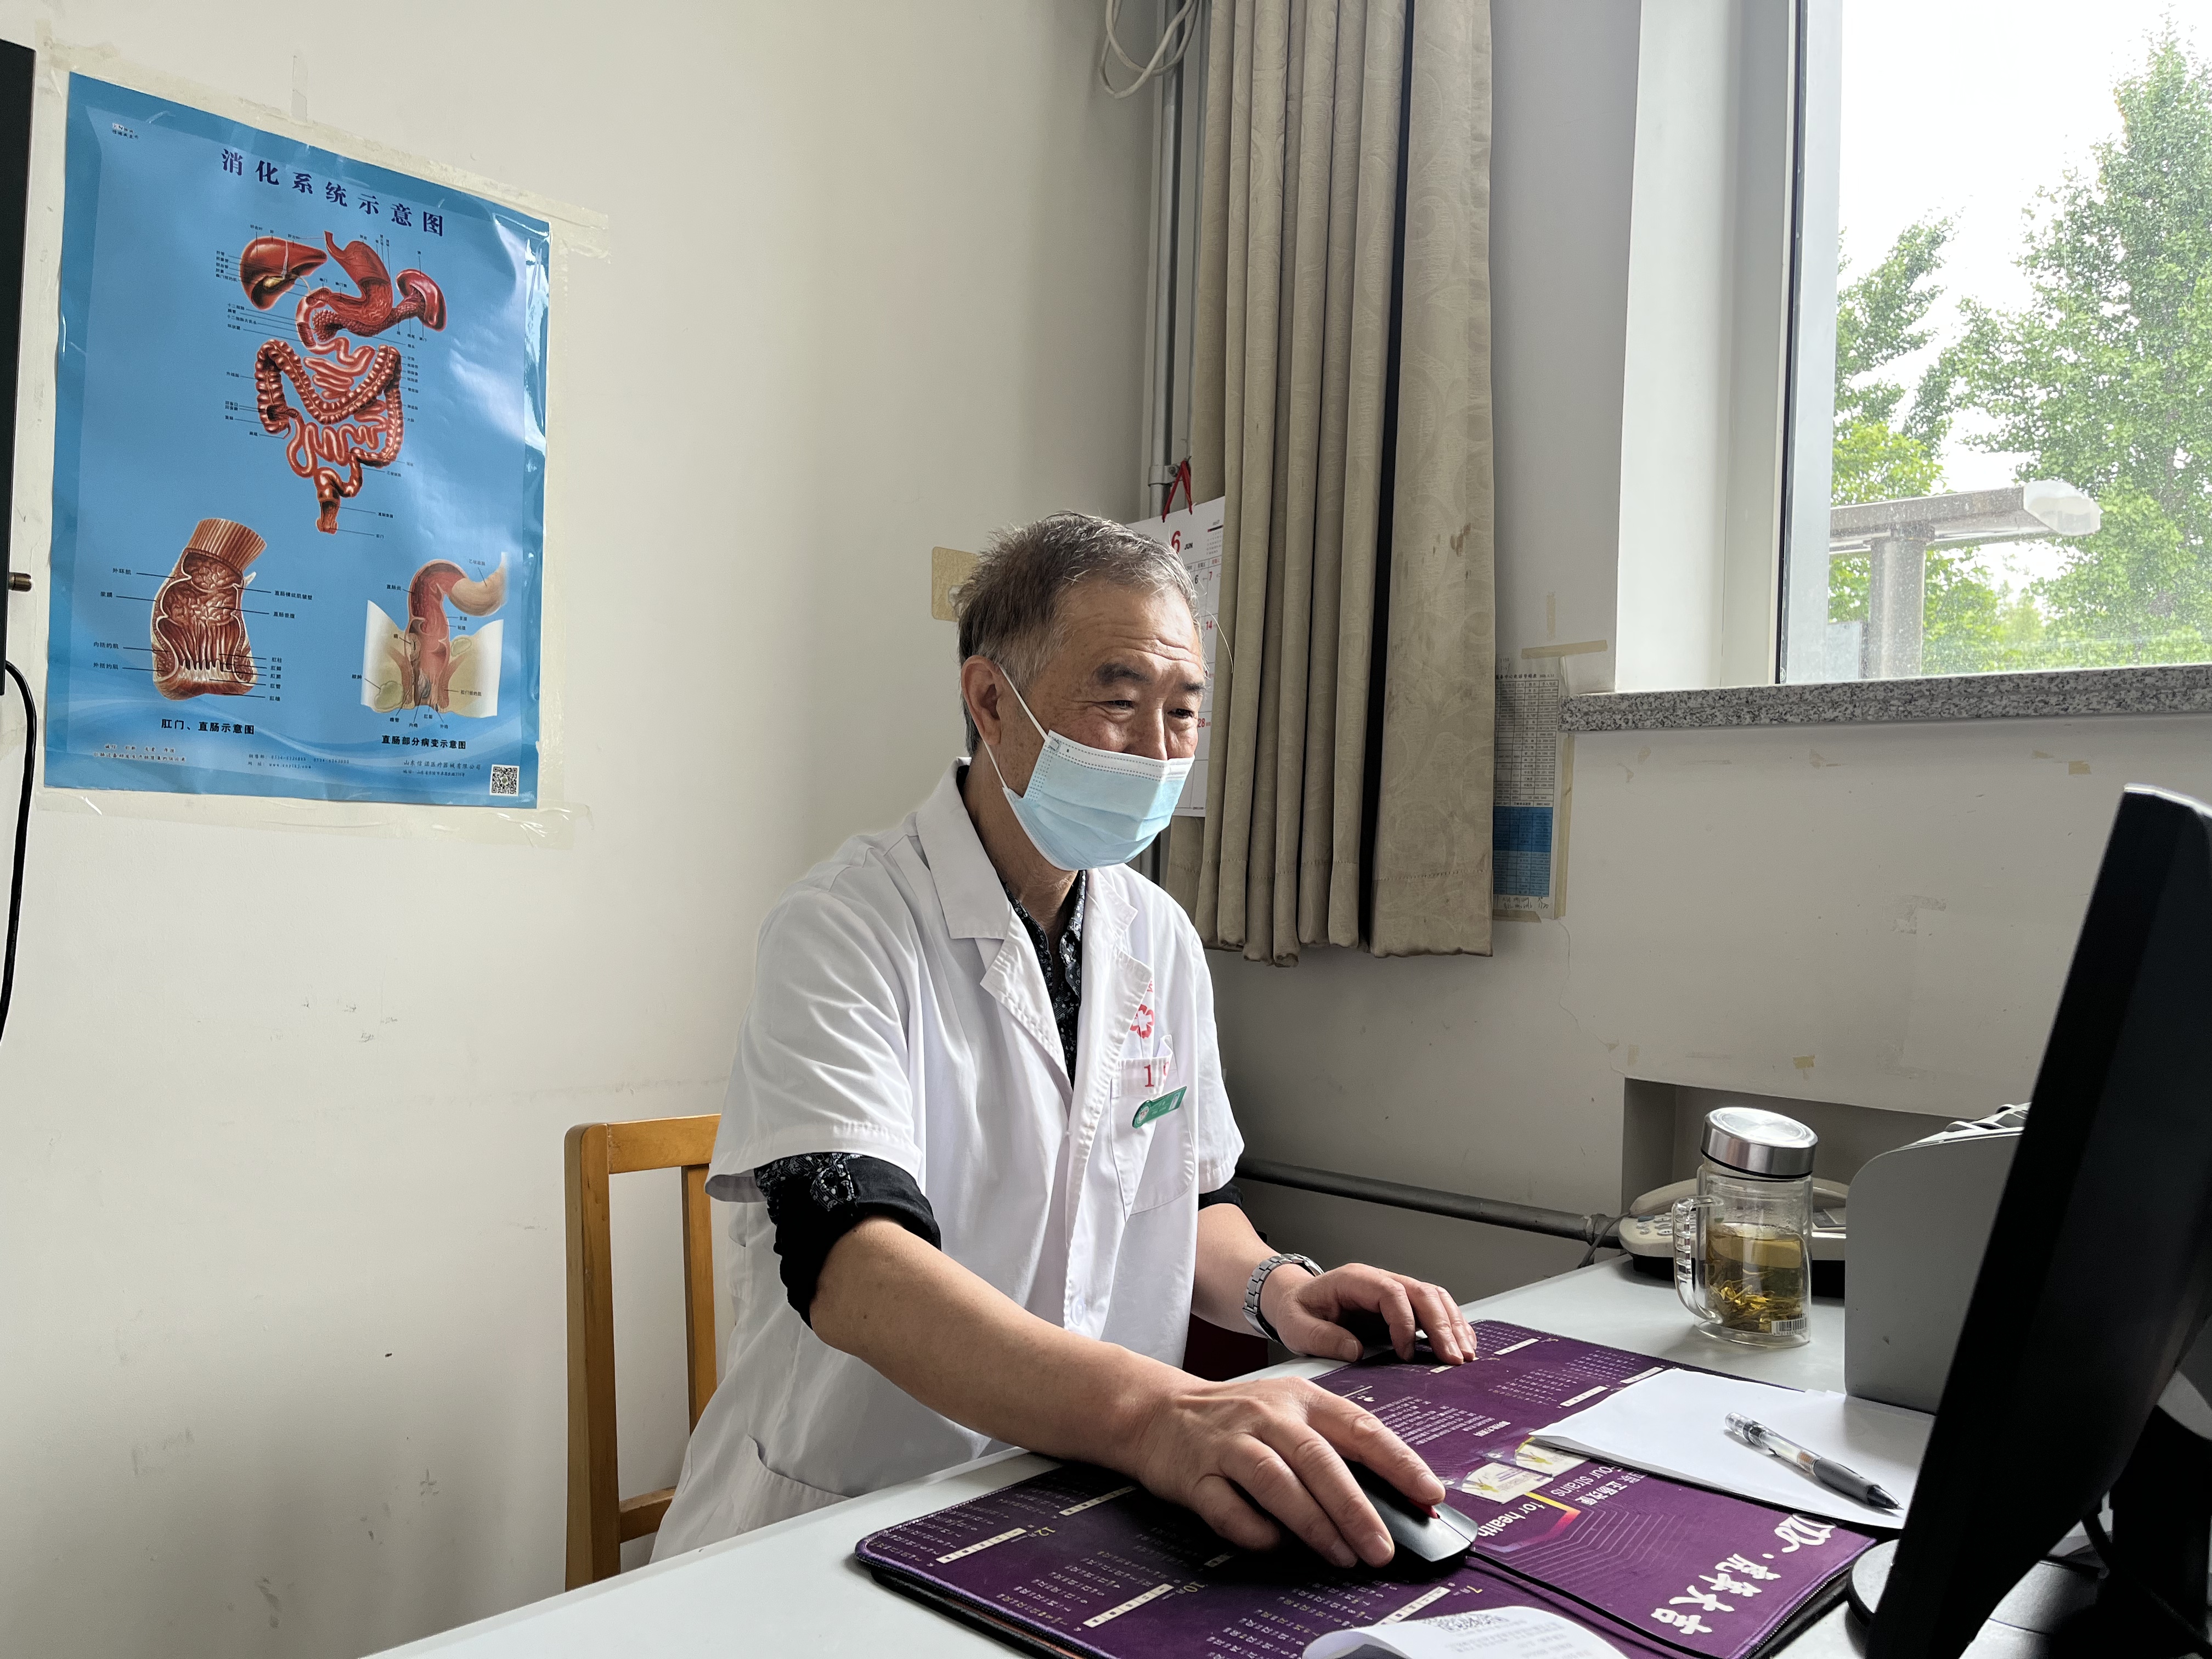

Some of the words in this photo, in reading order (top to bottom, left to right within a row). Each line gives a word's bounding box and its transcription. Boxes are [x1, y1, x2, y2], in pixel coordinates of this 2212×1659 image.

[221, 148, 443, 236] 消化系统示意图
[1171, 531, 1181, 554] 6
[1195, 574, 1199, 584] 6
[1209, 571, 1212, 581] 7
[1206, 620, 1212, 630] 14
[161, 719, 255, 735] 肛门、直肠示意图
[1197, 718, 1205, 727] 28
[381, 735, 466, 749] 直肠部分病变示意图
[1550, 1475, 1593, 1497] strains
[1575, 1481, 1628, 1506] 正肠改便
[1517, 1501, 1546, 1514] for
[1477, 1511, 1526, 1537] health
[1651, 1554, 1782, 1634] 虎年大吉
